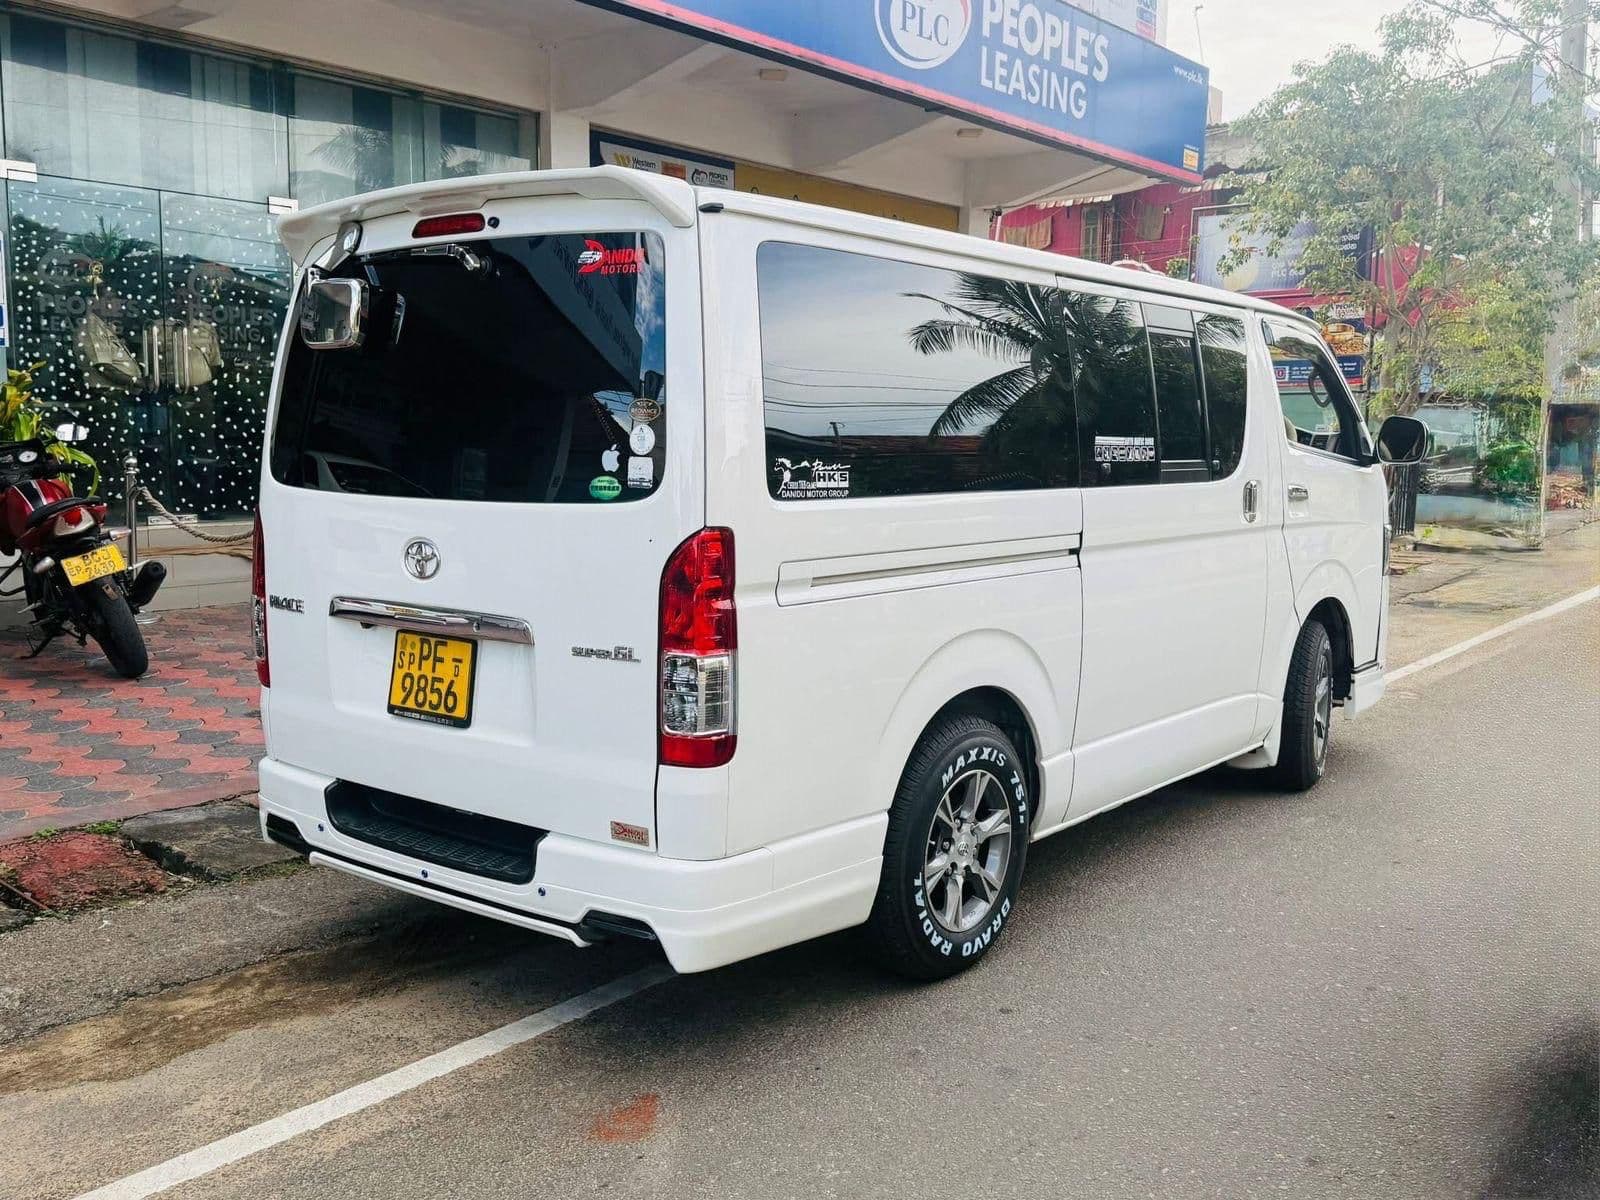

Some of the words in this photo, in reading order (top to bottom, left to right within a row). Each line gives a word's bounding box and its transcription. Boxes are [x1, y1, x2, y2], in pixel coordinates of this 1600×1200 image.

[899, 0, 950, 47] PLC
[982, 0, 1109, 82] PEOPLE'S
[980, 45, 1087, 119] LEASING
[632, 157, 657, 169] Western
[816, 471, 848, 487] HKS
[398, 650, 415, 671] SP
[417, 637, 448, 673] PF
[401, 672, 458, 713] 9856
[941, 747, 1008, 789] MAXXIS
[913, 871, 953, 957] RADIAL
[961, 897, 1012, 958] BRAVO
